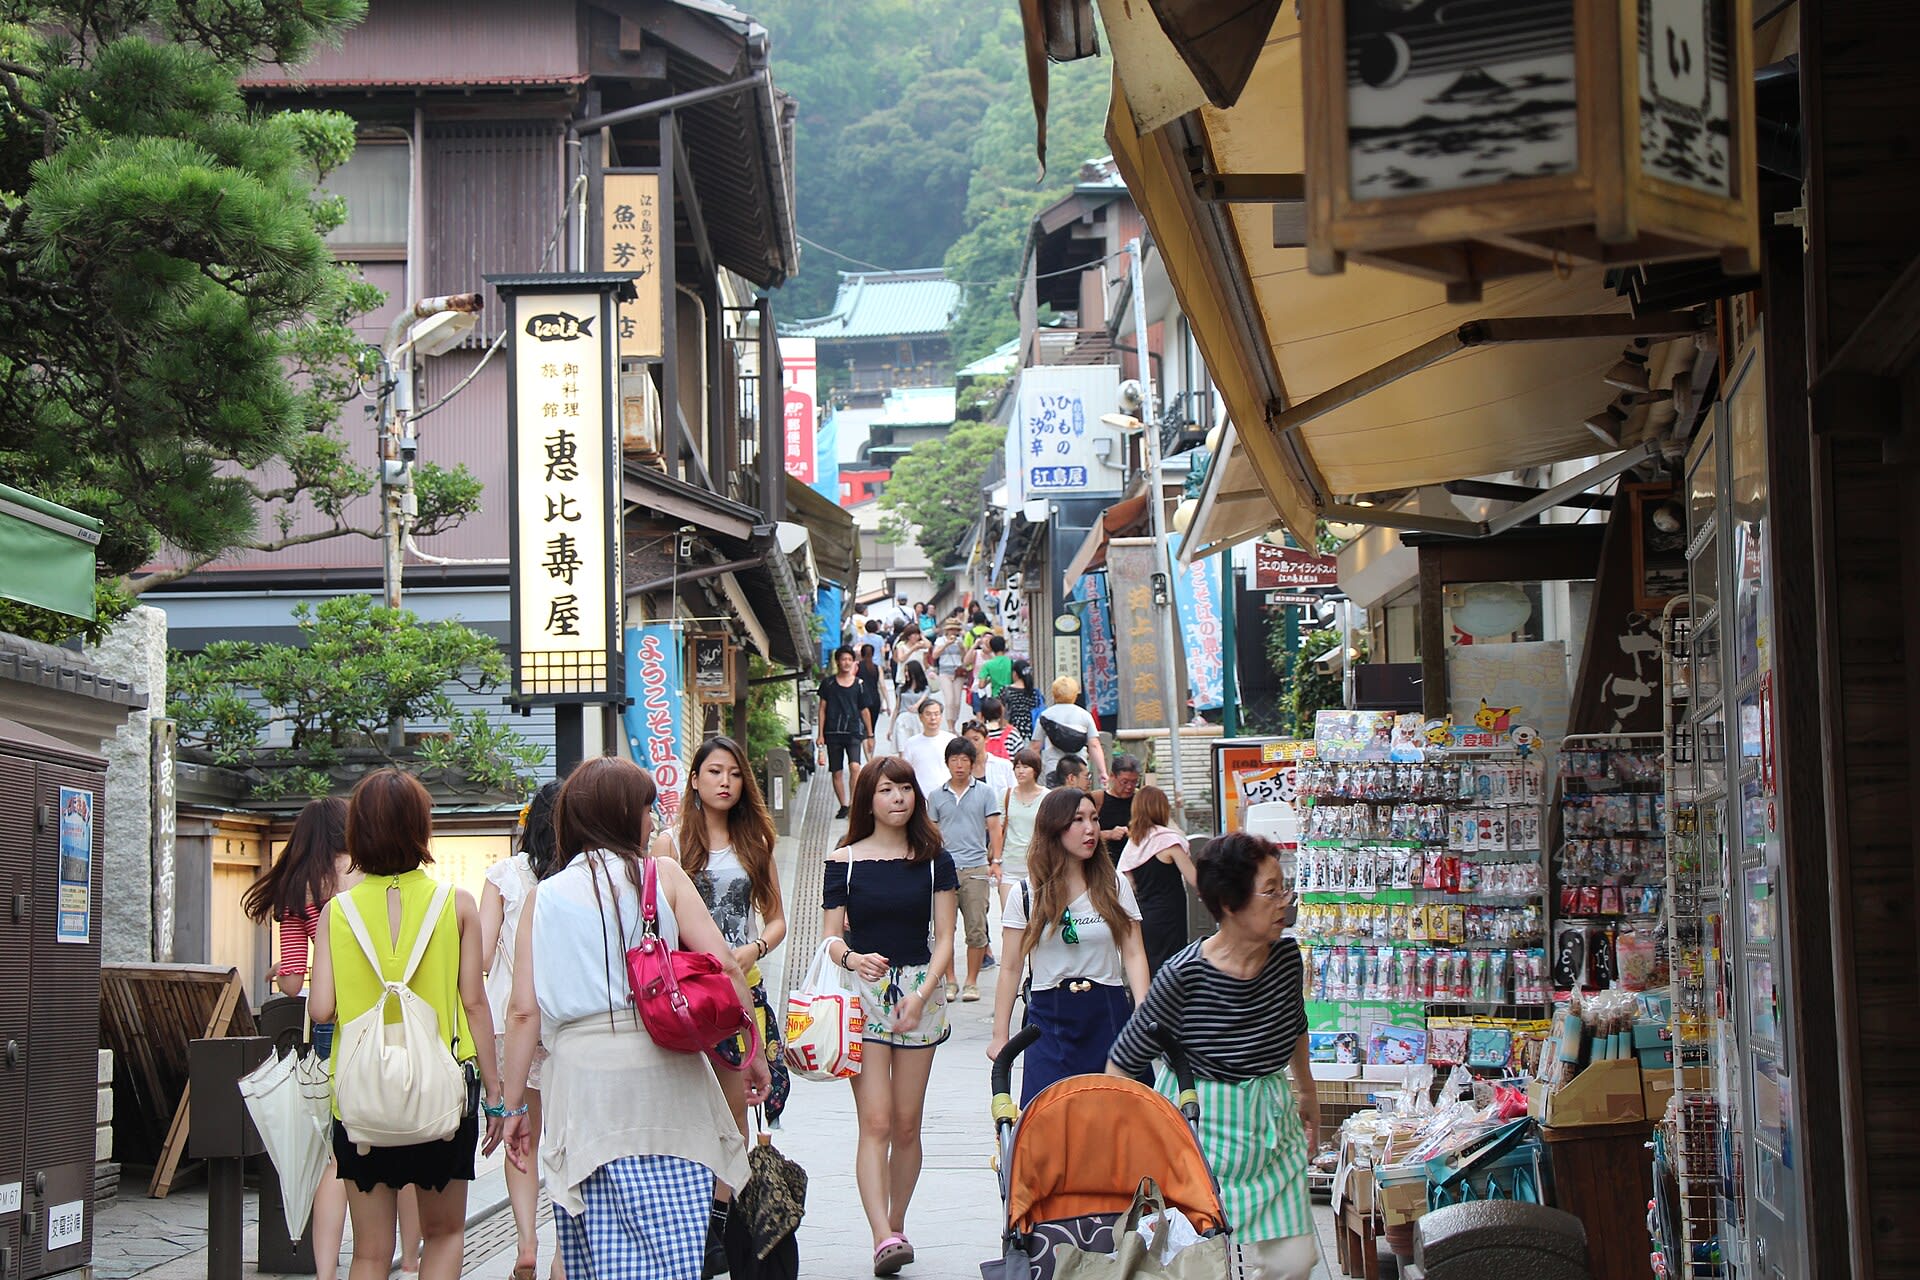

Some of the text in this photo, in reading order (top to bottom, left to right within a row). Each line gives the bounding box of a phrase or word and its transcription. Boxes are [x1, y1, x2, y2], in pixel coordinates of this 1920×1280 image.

[612, 204, 637, 338] 魚芳店
[540, 363, 559, 417] 旅館
[791, 418, 801, 456] 郵便局
[1057, 395, 1071, 455] ひもの
[1034, 467, 1084, 486] 江島屋
[1259, 546, 1284, 557] ようこそ
[1242, 772, 1286, 798] しらす
[9, 1189, 18, 1205] 67
